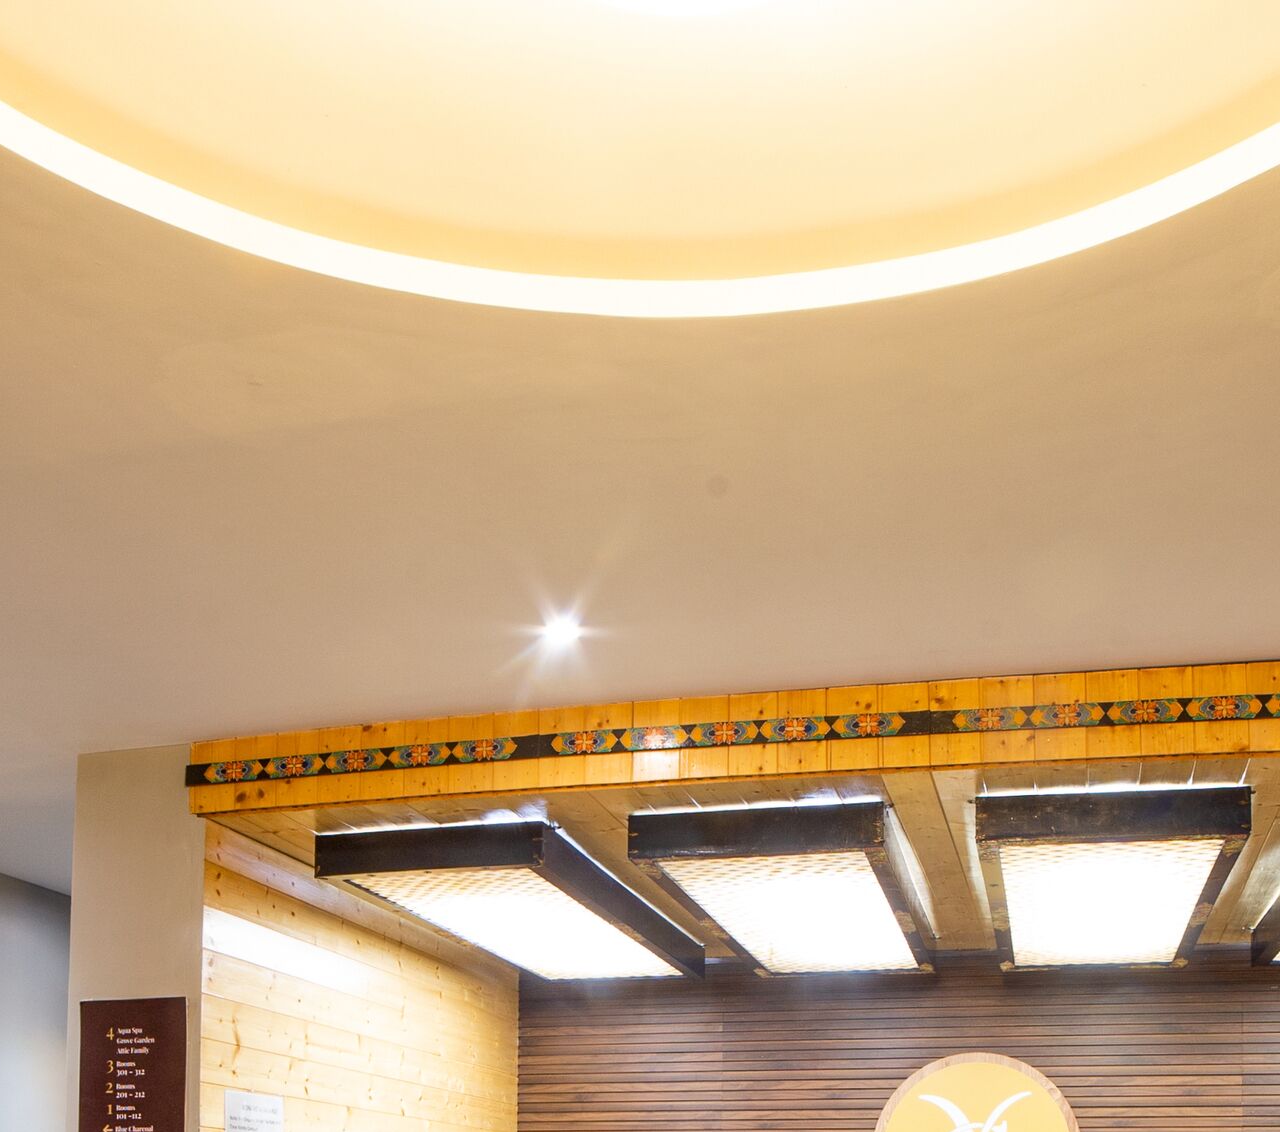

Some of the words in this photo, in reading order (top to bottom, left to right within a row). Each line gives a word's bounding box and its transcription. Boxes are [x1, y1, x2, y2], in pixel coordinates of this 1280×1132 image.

[106, 1027, 115, 1041] 4
[131, 1027, 143, 1035] Spa
[106, 1060, 114, 1074] 3
[116, 1069, 128, 1077] 301
[135, 1069, 146, 1077] 312
[105, 1082, 114, 1094] 2
[116, 1091, 128, 1099] 201
[107, 1104, 113, 1115] 1
[115, 1125, 128, 1132] Blue
